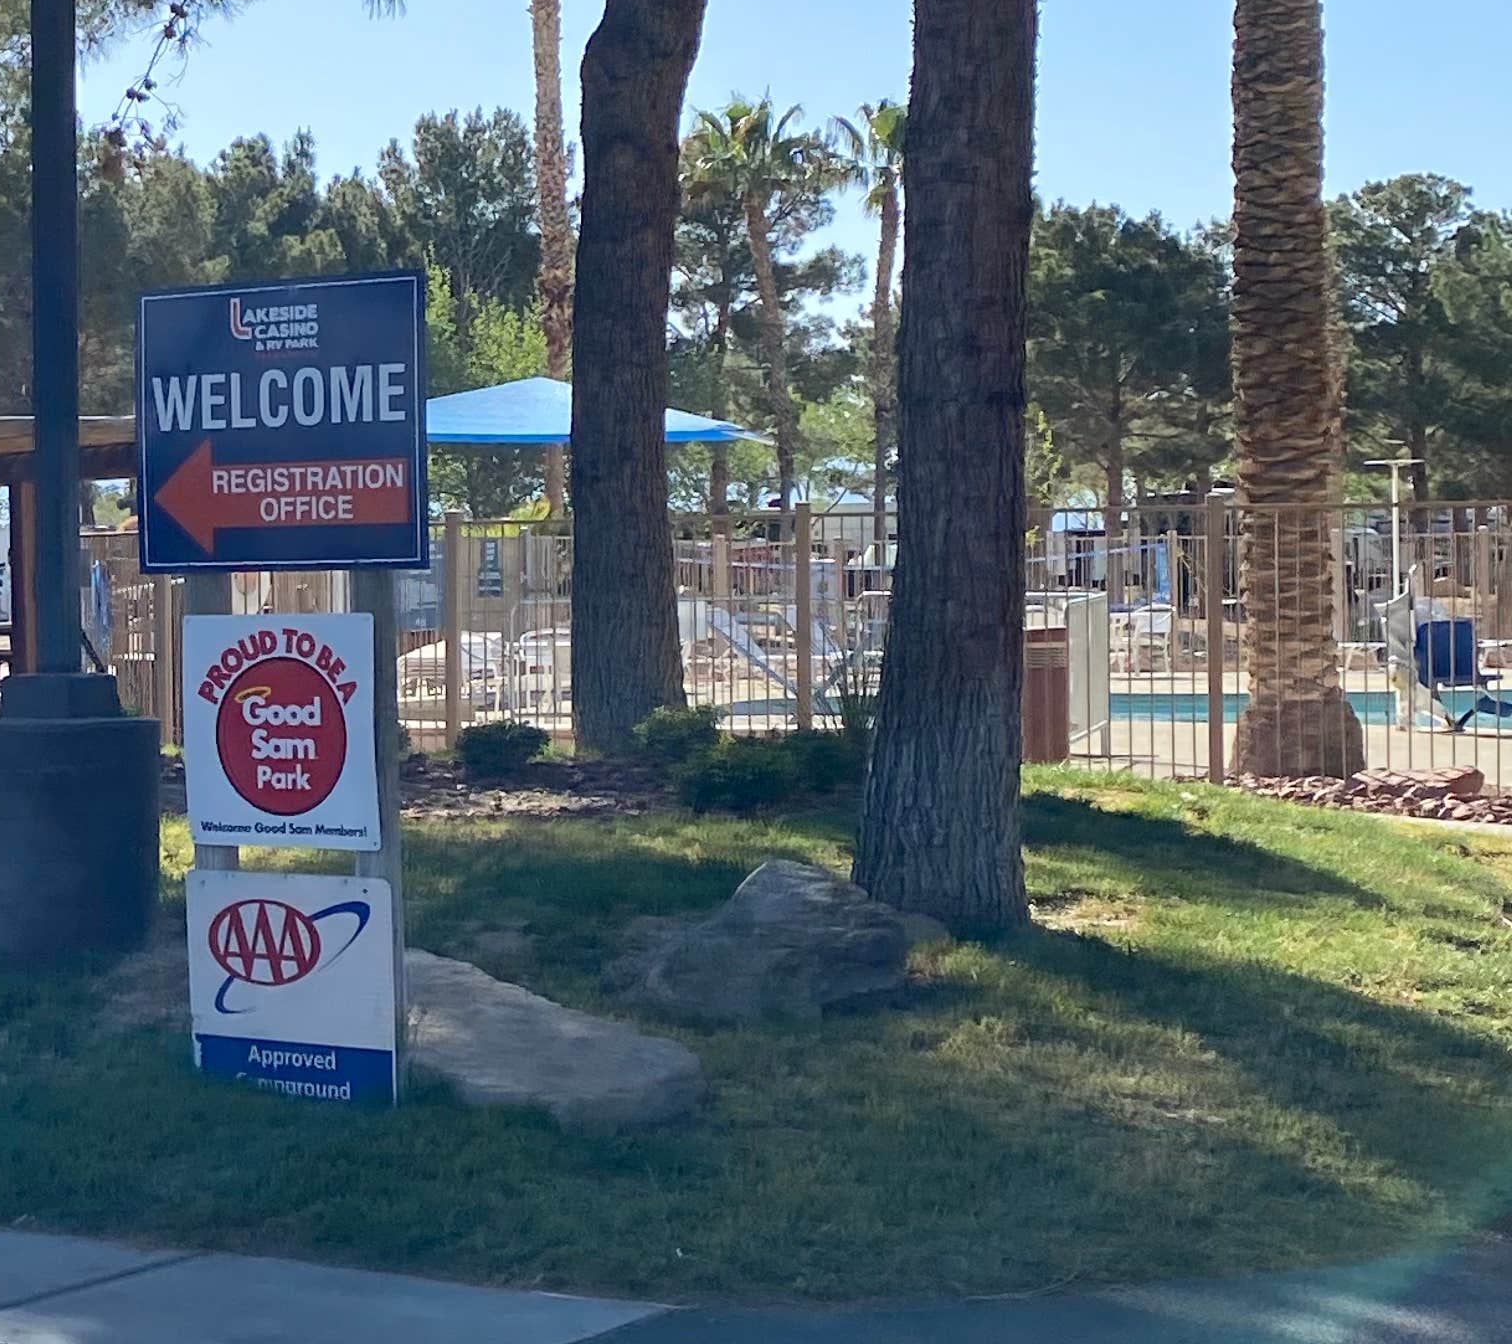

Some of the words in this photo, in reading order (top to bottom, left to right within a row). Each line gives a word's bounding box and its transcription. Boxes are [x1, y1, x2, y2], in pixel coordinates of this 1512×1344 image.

[230, 297, 318, 340] LAKESIDE
[254, 321, 319, 339] CASINO
[255, 341, 265, 351] &
[266, 340, 283, 351] RV
[285, 337, 319, 349] PARK
[152, 363, 407, 432] WELCOME
[212, 464, 404, 494] REGISTRATION
[260, 496, 355, 522] OFFICE
[198, 630, 278, 705] PROUD
[282, 628, 316, 658] TO
[316, 644, 346, 684] BE
[336, 681, 358, 705] A
[242, 695, 322, 726] Good
[251, 729, 316, 760] Sam
[257, 764, 311, 790] Park
[201, 821, 251, 833] Welcome
[254, 821, 286, 834] Good
[289, 823, 313, 835] Sam
[315, 824, 368, 837] Members!
[222, 901, 308, 984] AAA
[248, 1044, 336, 1071] Approved
